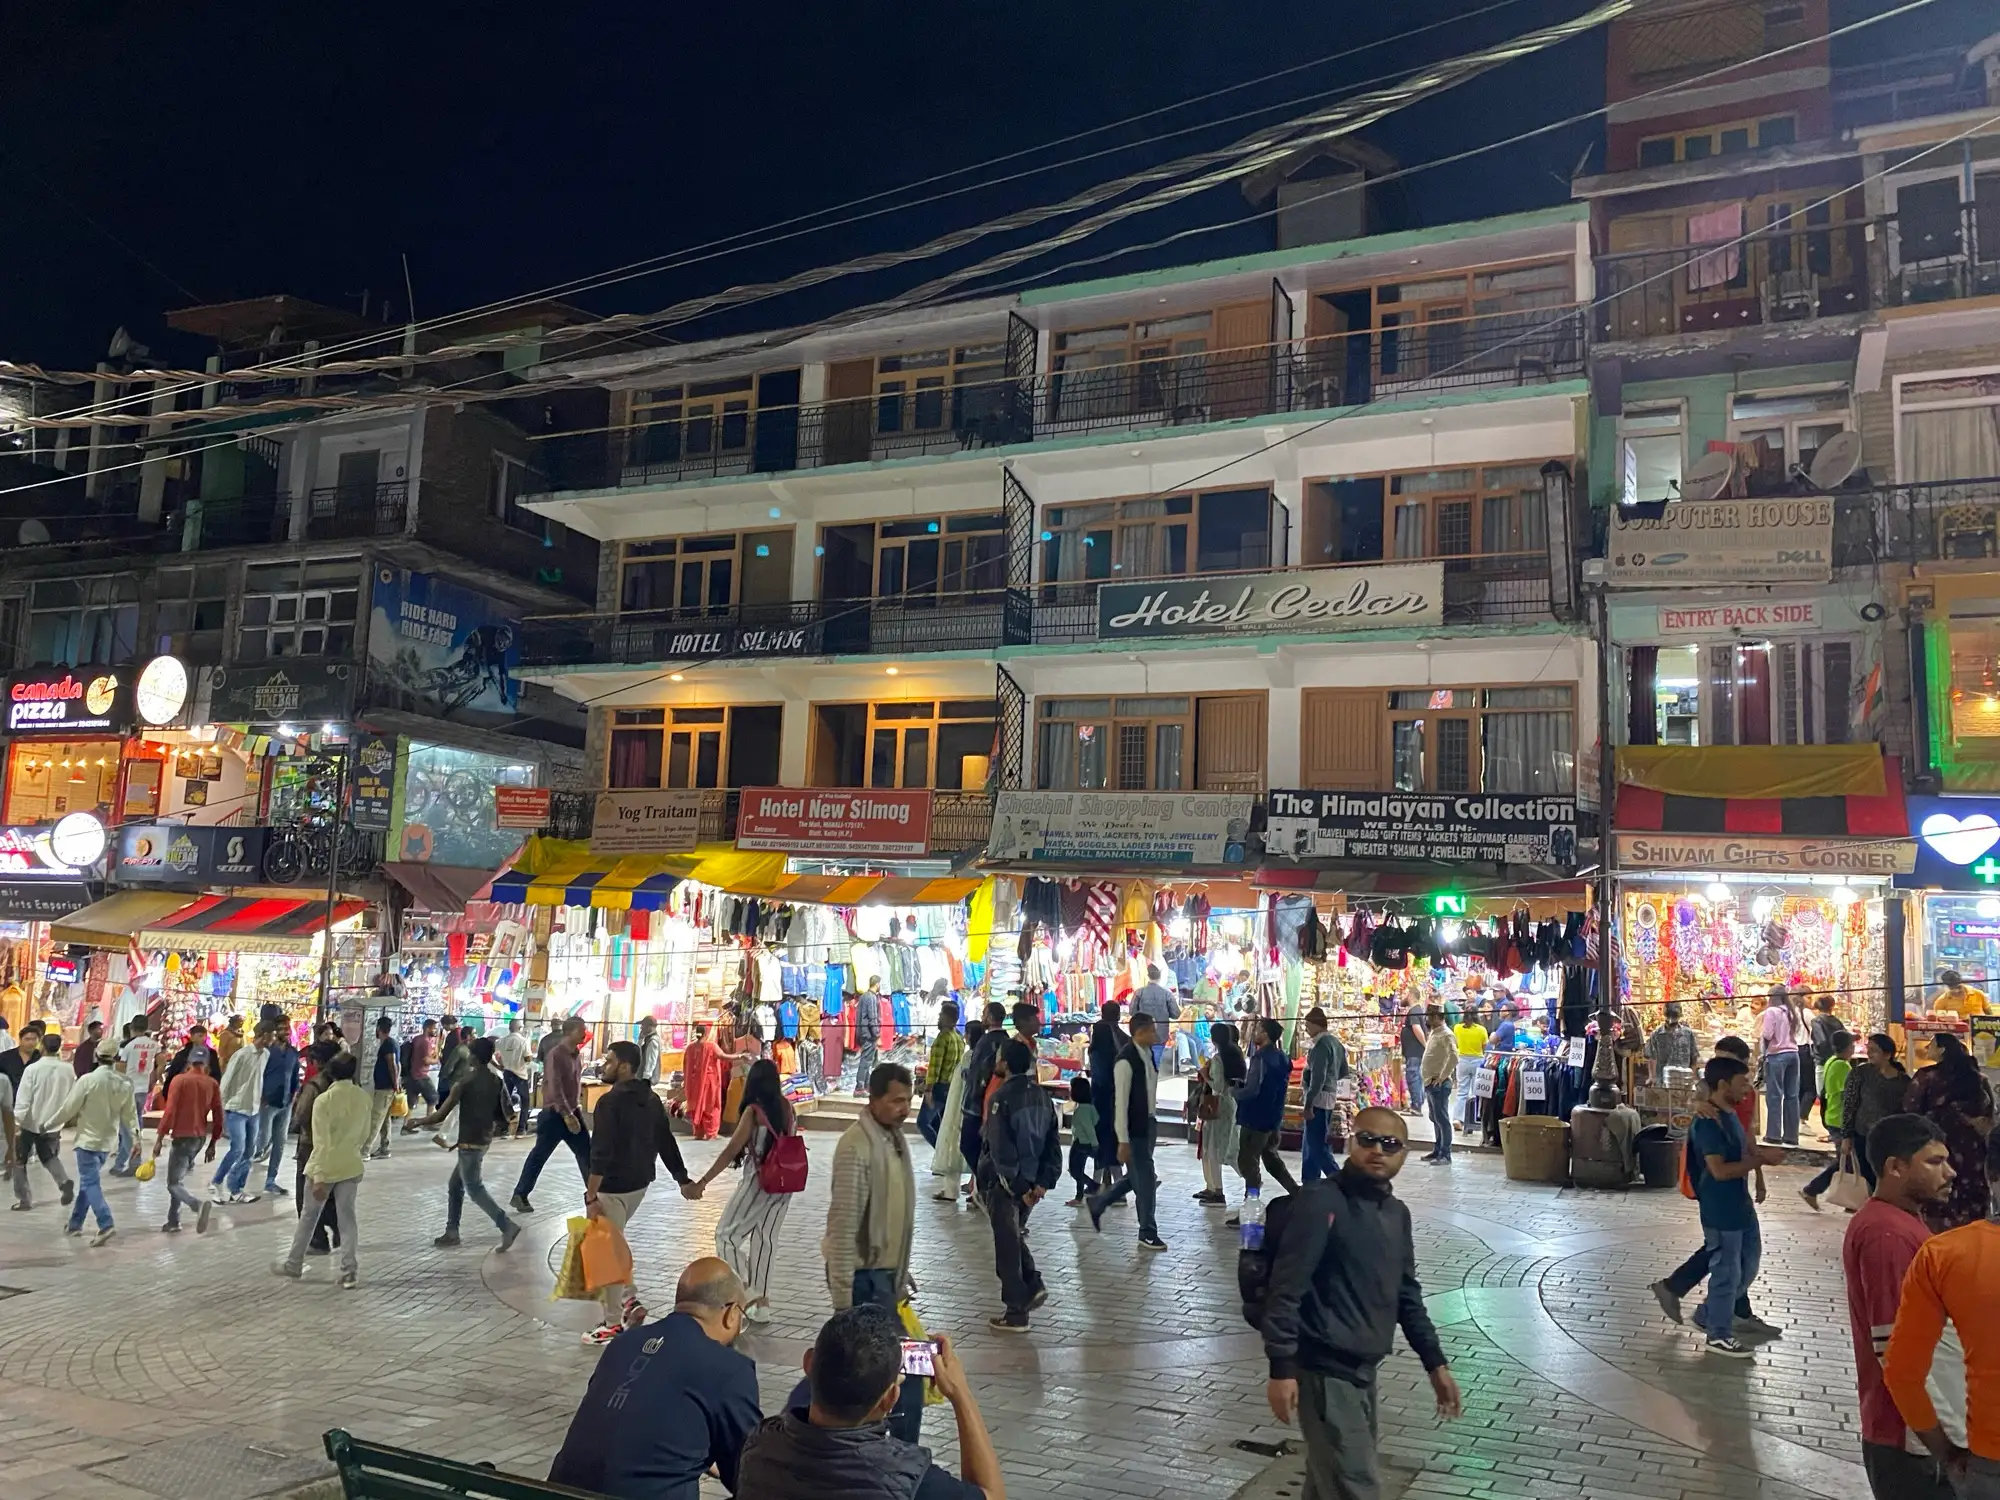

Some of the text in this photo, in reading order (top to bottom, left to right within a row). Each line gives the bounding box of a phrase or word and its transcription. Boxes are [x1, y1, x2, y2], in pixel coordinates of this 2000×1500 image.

[1747, 502, 1830, 529] HOUSE
[1777, 550, 1825, 563] DELL
[1109, 578, 1428, 629] Hotel Cedar
[400, 601, 456, 631] RIDE HARD
[1665, 604, 1814, 629] ENTRY BACK SIDE
[400, 619, 454, 648] RIDE FAST
[1266, 622, 1297, 630] MANALI
[669, 630, 805, 654] HOTEL SILMOG
[11, 675, 83, 702] canada
[10, 701, 67, 730] pizza
[618, 805, 698, 823] Yog Traitam
[759, 798, 910, 825] Hotel New Silmog
[998, 793, 1251, 822] Shashni Shopping Center
[1273, 793, 1575, 823] The Himalayan Collection
[1078, 820, 1098, 828] We
[1101, 821, 1135, 830] Deals
[1363, 821, 1388, 830] WE
[1392, 822, 1445, 832] DEALS
[1169, 832, 1218, 841] JEWELLERY
[1318, 828, 1360, 840] TRAVELLING
[1360, 829, 1379, 840] BAGS
[1400, 830, 1422, 842] ITEMS
[1508, 834, 1549, 846] GARMENTS
[1065, 850, 1093, 858] MALL
[1121, 842, 1153, 850] LADIES
[1153, 843, 1177, 851] PARS
[1631, 840, 1898, 869] SHIVAM GIFTS CORNER
[216, 865, 256, 873] SCOTT
[8, 900, 32, 909] Arts
[143, 936, 302, 954] VANI GIFT CENTER
[1571, 1053, 1583, 1061] 300
[1477, 1072, 1492, 1082] SALE
[1476, 1083, 1491, 1092] 300
[1527, 1086, 1543, 1095] 300
